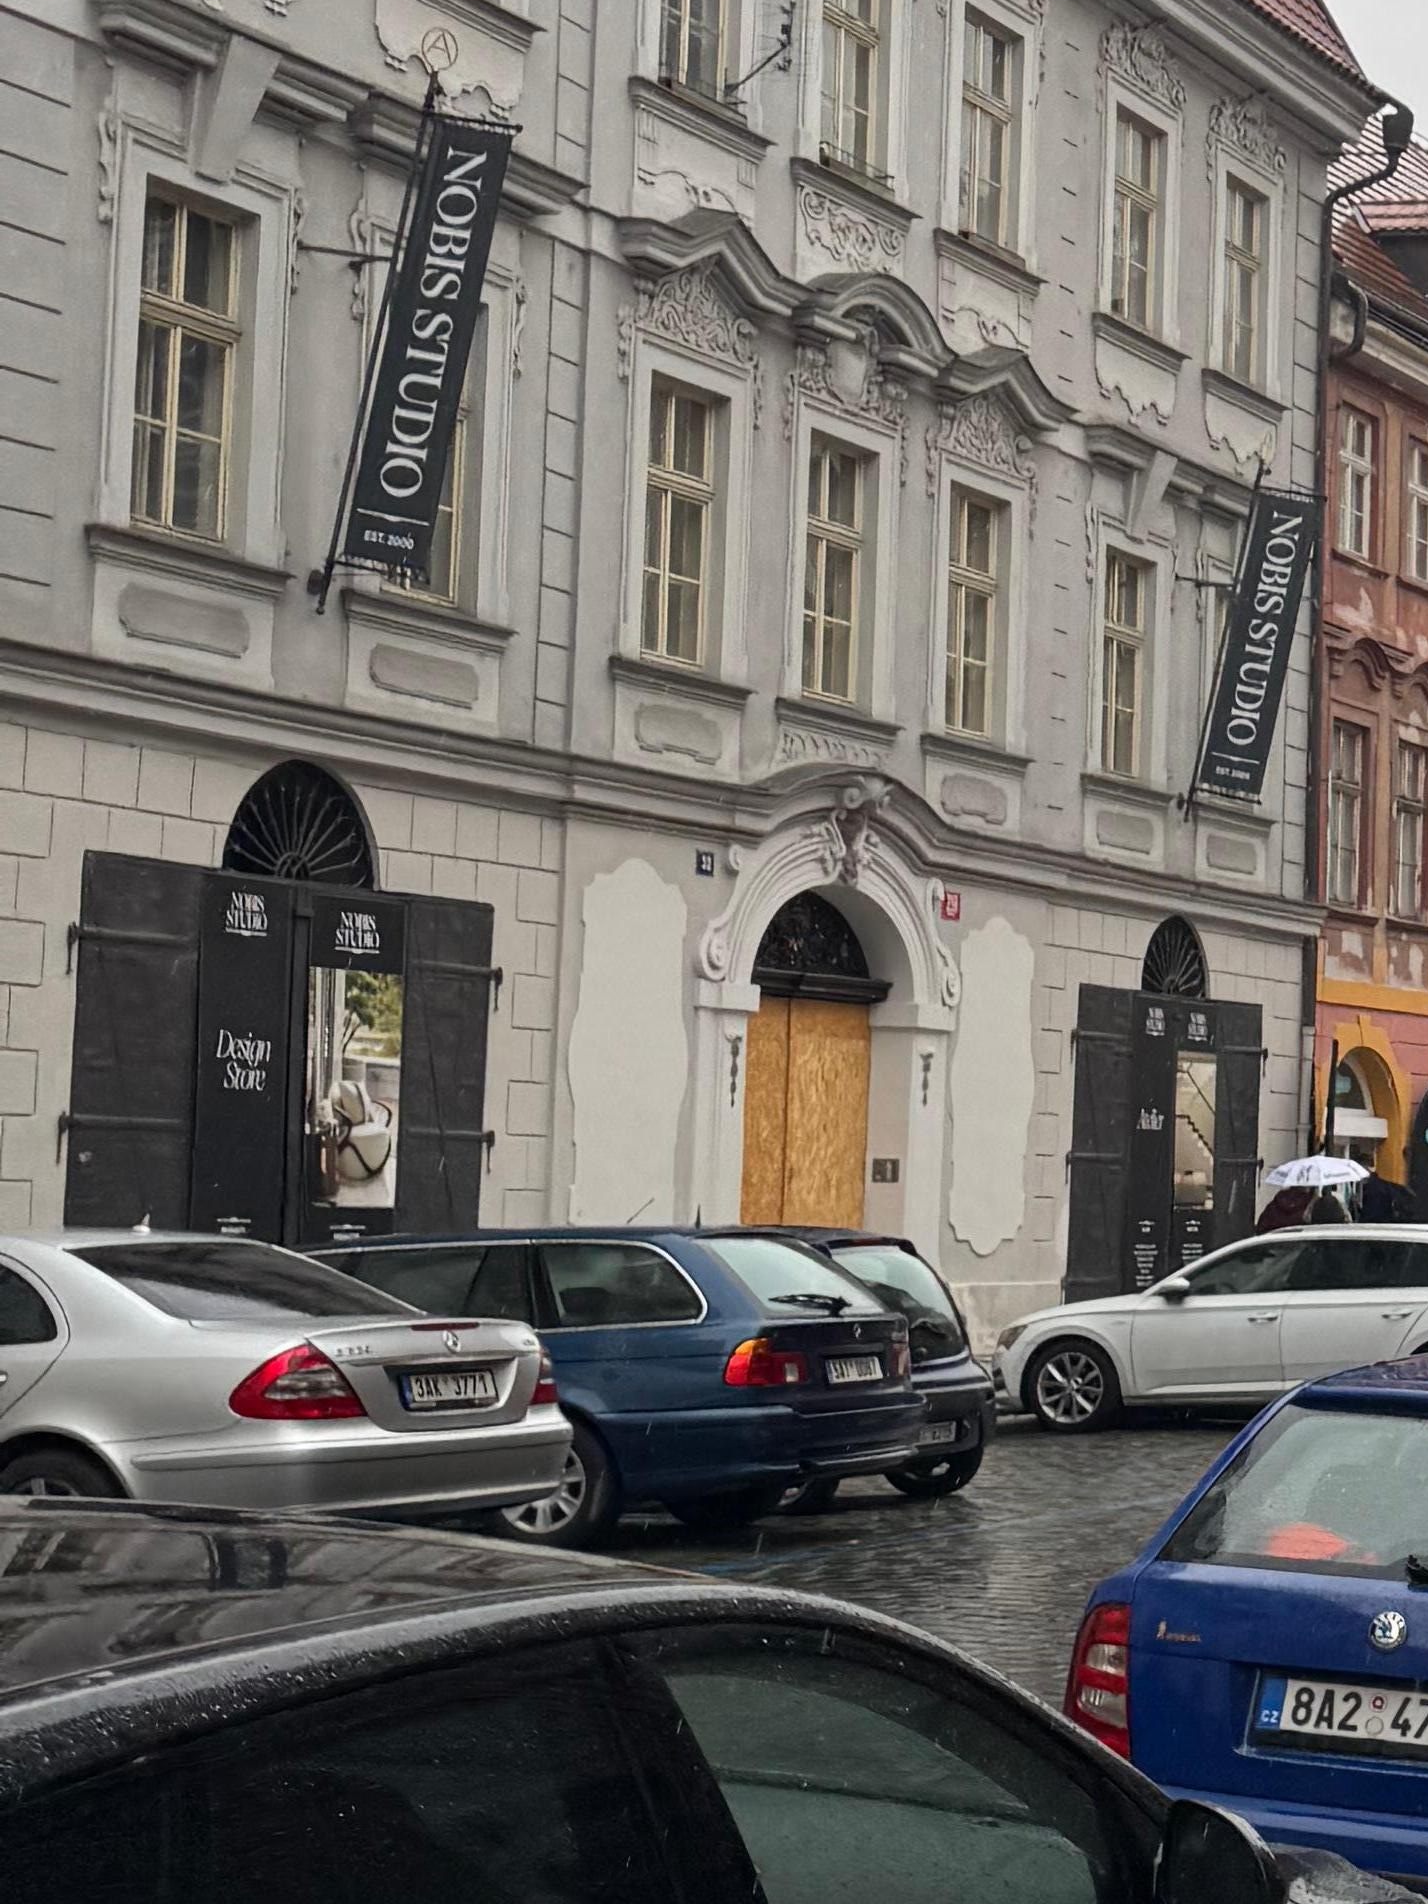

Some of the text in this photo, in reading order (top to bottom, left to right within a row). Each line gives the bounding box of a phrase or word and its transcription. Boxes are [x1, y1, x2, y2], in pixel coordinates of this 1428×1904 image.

[379, 145, 488, 498] NOBIS STUDIO
[1226, 510, 1303, 746] NOBIS STUDIO
[216, 1029, 272, 1067] Design
[223, 1061, 267, 1091] Store
[415, 1377, 442, 1397] 3AK
[1260, 1709, 1280, 1724] CZ
[1291, 1686, 1363, 1732] 8A2
